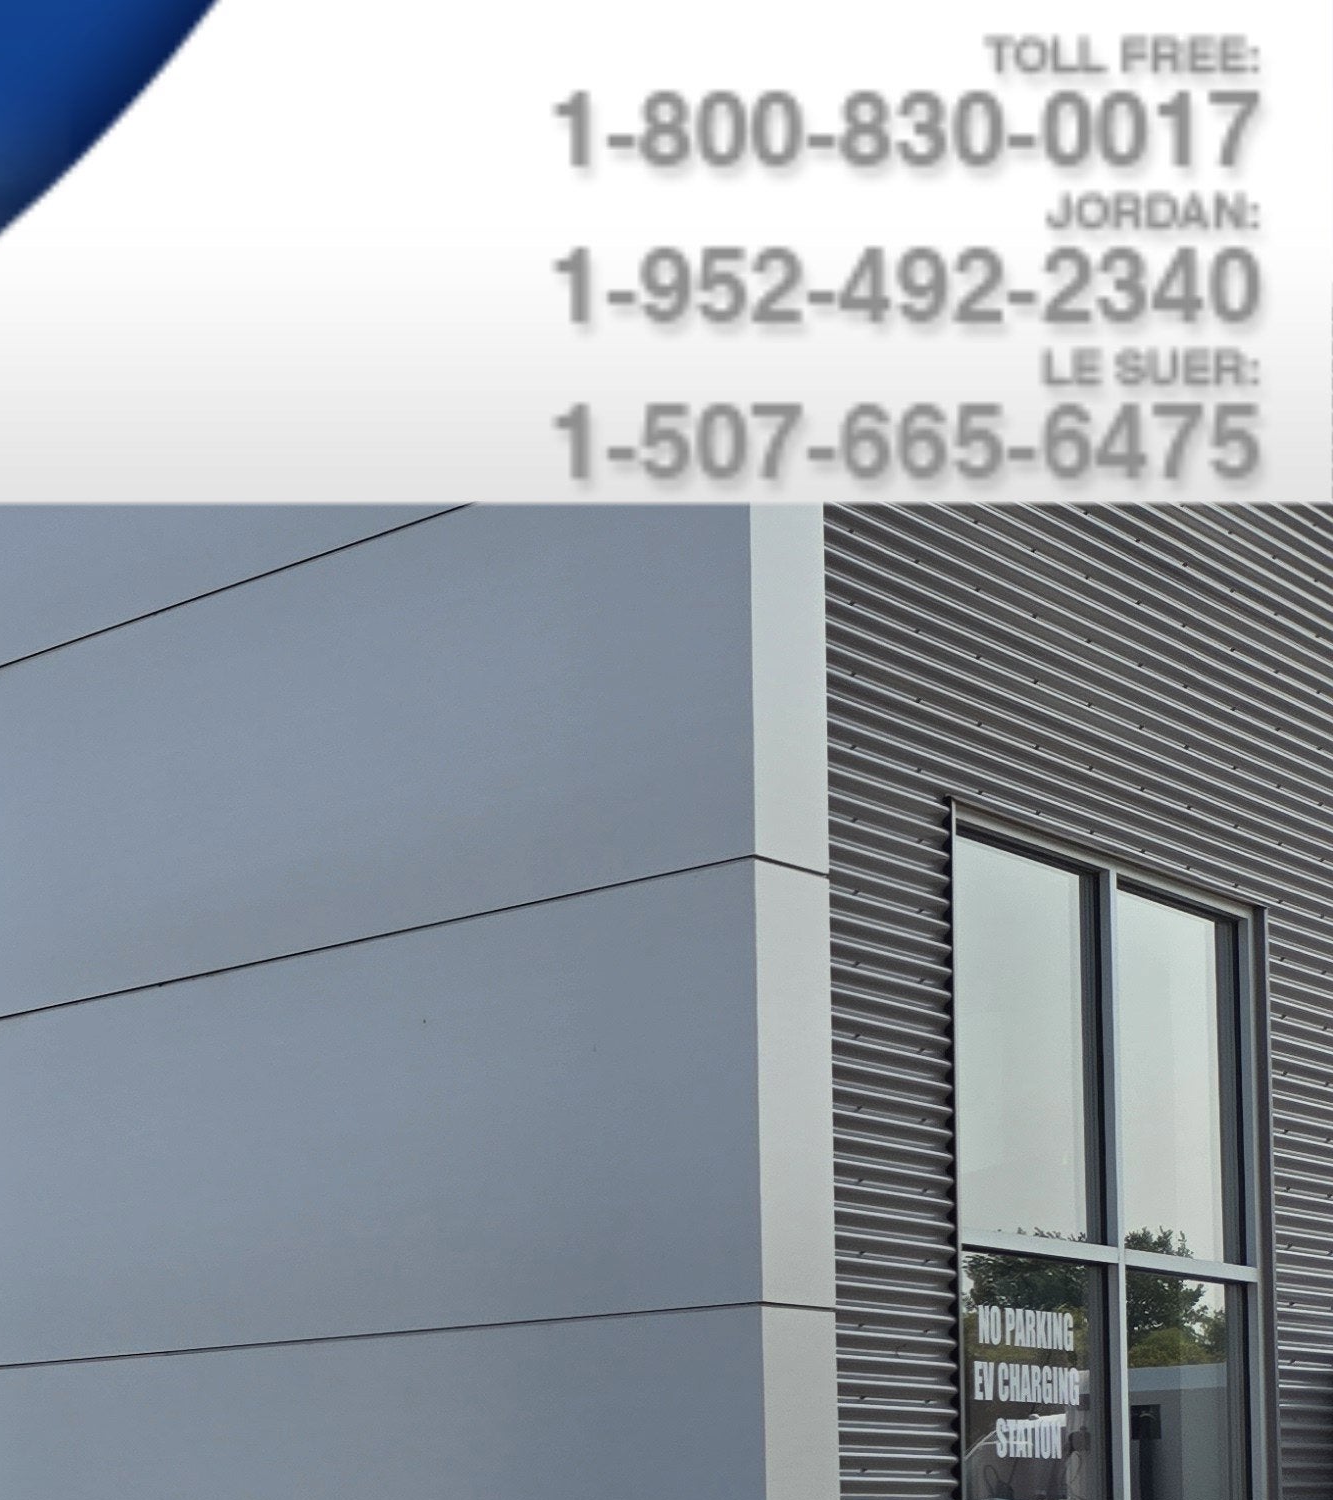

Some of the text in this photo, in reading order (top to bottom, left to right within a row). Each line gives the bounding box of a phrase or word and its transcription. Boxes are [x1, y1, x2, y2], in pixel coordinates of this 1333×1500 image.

[978, 1304, 1074, 1352] NO PARKING
[974, 1361, 1080, 1406] EV CHARGING
[996, 1417, 1062, 1459] STATION
